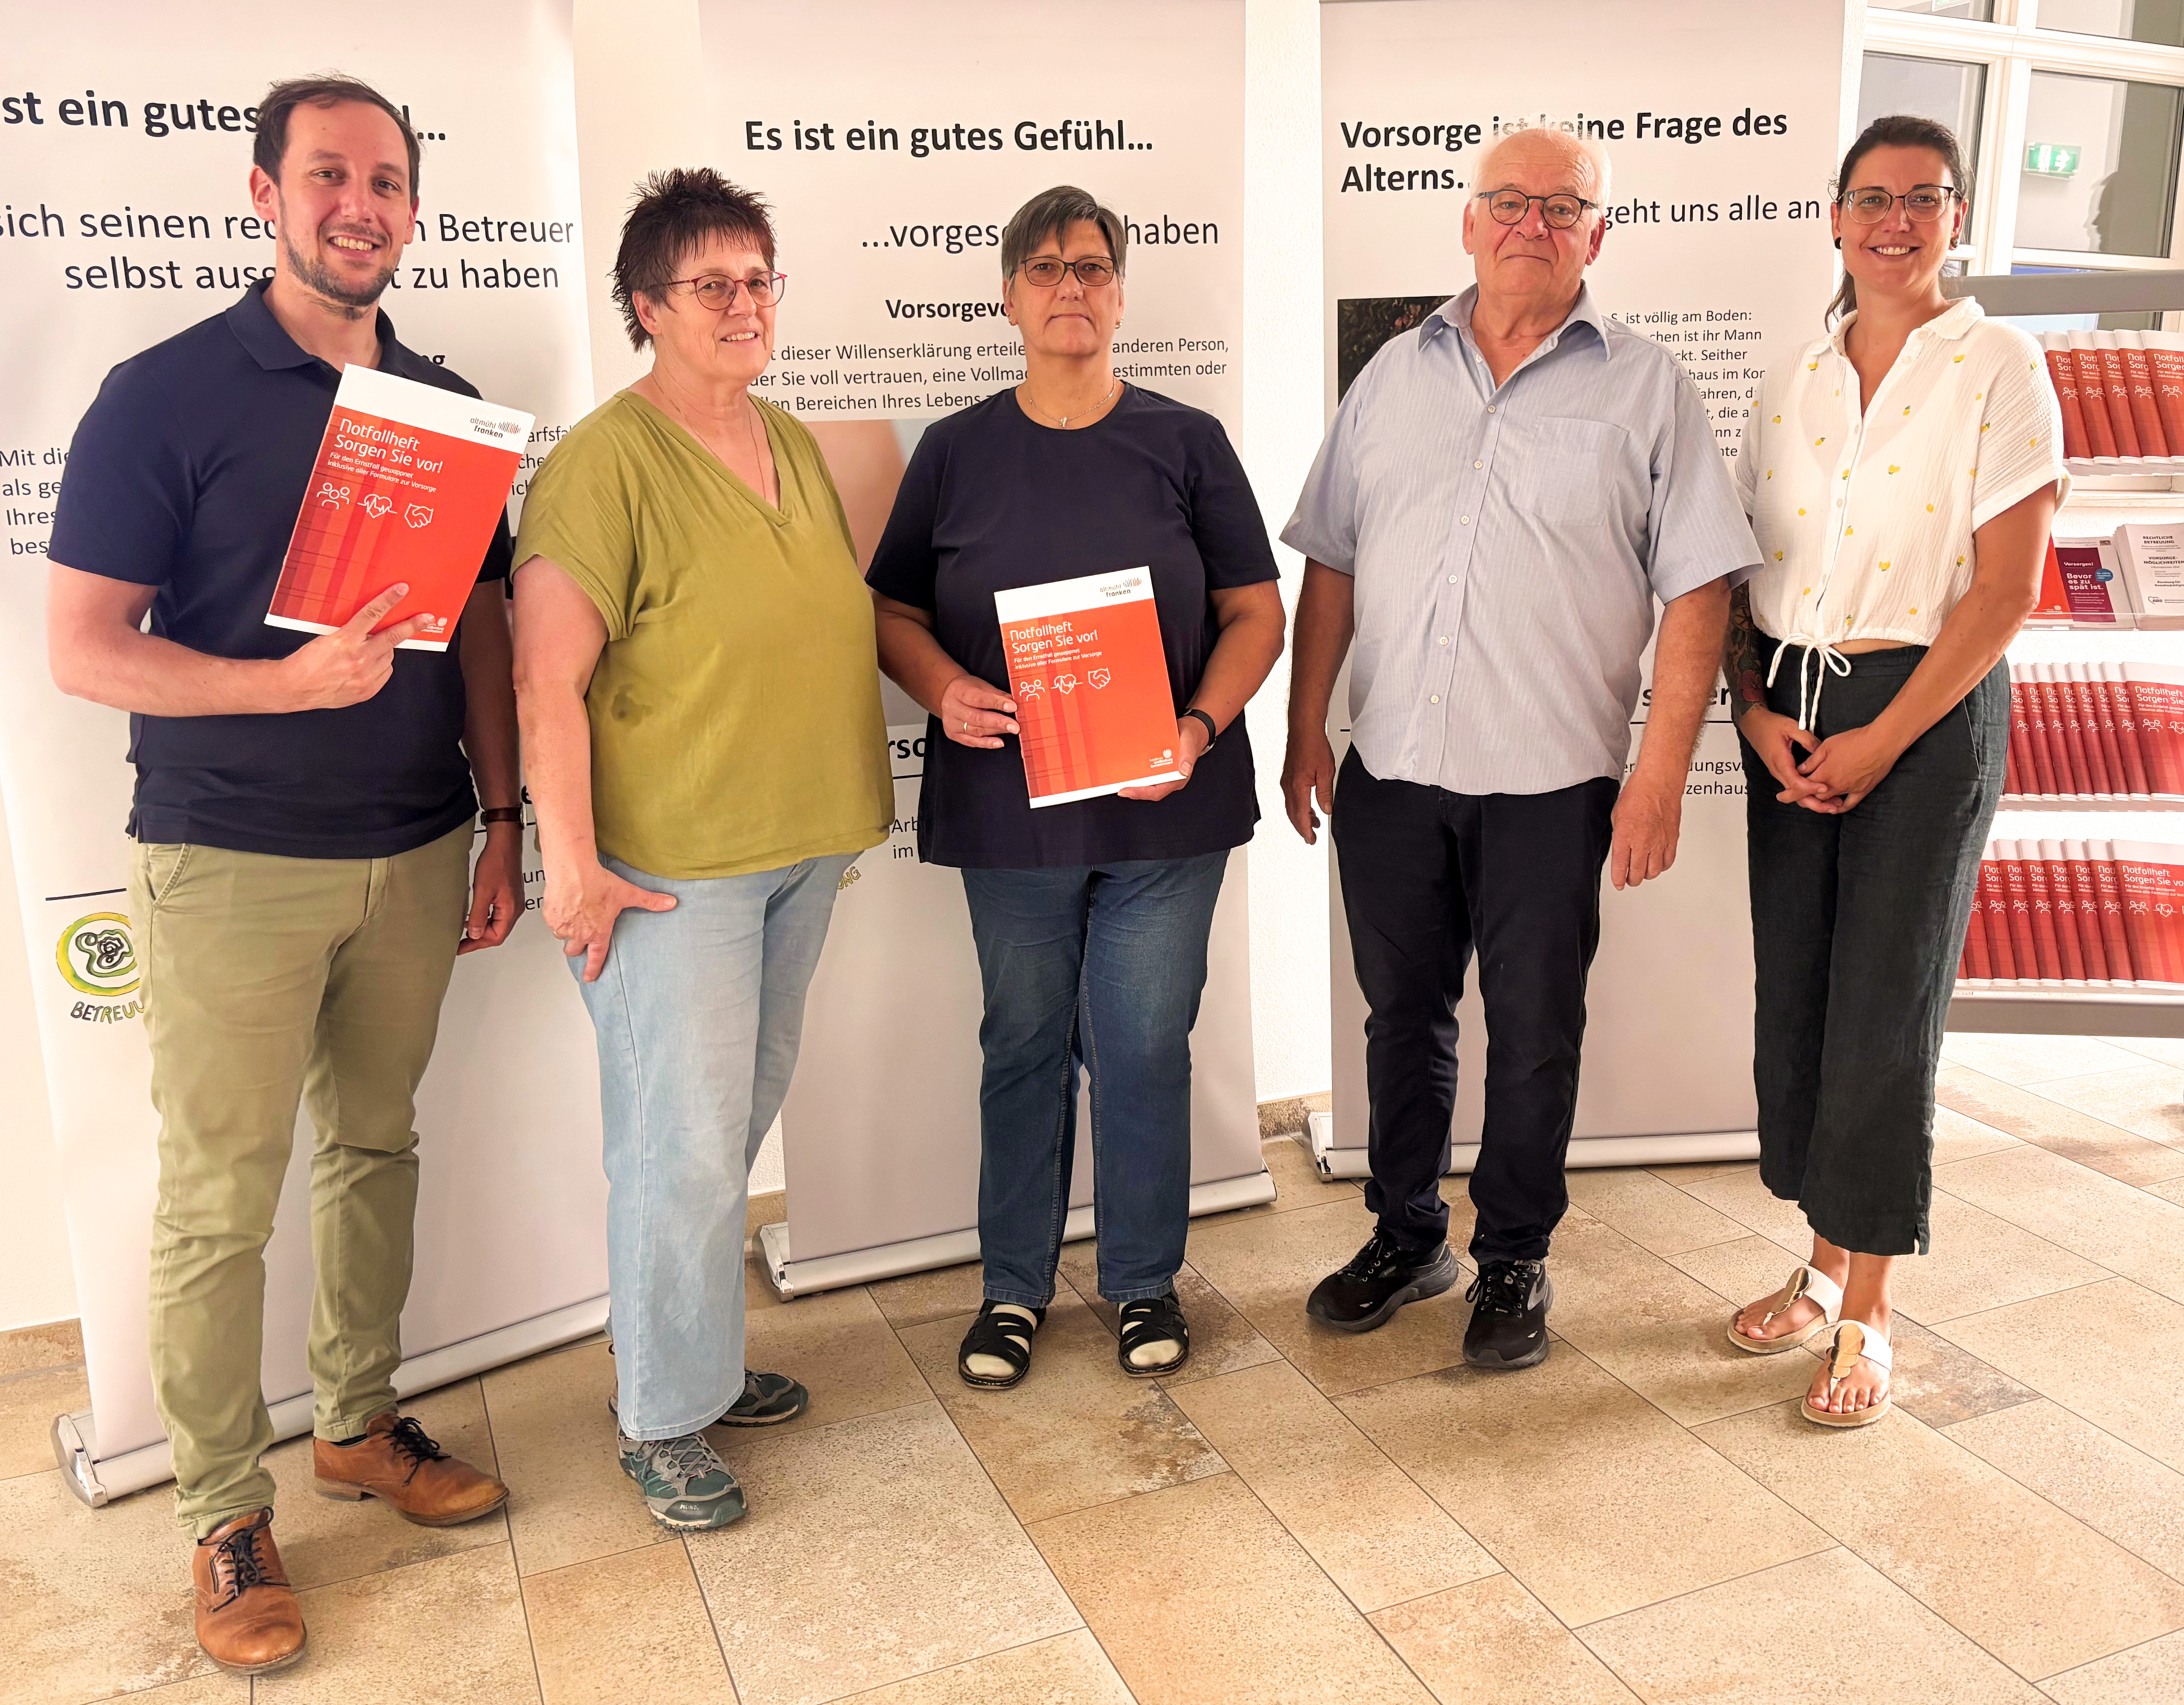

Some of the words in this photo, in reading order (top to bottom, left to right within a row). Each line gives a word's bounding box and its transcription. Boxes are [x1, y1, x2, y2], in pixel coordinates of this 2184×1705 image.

[2, 92, 44, 124] st
[58, 90, 128, 127] ein
[144, 99, 259, 137] gutes
[746, 121, 782, 150] Es
[794, 120, 834, 150] ist
[846, 120, 898, 150] ein
[911, 124, 1003, 157] gutes
[1014, 120, 1152, 150] Gefühl...
[1340, 122, 1481, 151] Vorsorge
[1637, 112, 1721, 144] Frage
[1732, 108, 1787, 136] des
[1671, 202, 1718, 222] uns
[1729, 195, 1777, 221] alle
[1788, 200, 1819, 219] an
[0, 204, 65, 237] ich
[80, 207, 210, 239] seinen
[439, 214, 573, 243] Betreuer
[1124, 215, 1218, 245] haben
[65, 256, 182, 289] selbst
[412, 267, 448, 288] zu
[461, 259, 558, 288] haben
[1626, 313, 1640, 324] ist
[1644, 312, 1678, 325] völlig
[1682, 313, 1702, 322] am
[1706, 309, 1752, 321] Boden:
[1684, 330, 1699, 342] ist
[1703, 330, 1720, 341] ihr
[1724, 329, 1762, 340] Mann
[781, 345, 831, 360] dieser
[836, 343, 972, 360] Willenserklärung
[977, 341, 1026, 357] erteile
[1113, 338, 1173, 353] anderen
[1178, 338, 1229, 353] Person,
[1701, 349, 1747, 360] Seither
[2154, 354, 2184, 363] Notfall
[782, 371, 805, 385] Sie
[811, 370, 838, 385] voll
[844, 369, 927, 385] vertrauen,
[932, 368, 966, 382] eine
[970, 366, 1028, 381] Vollma
[1113, 364, 1190, 377] estimmten
[1196, 361, 1227, 375] oder
[1722, 368, 1738, 379] im
[796, 395, 880, 411] Bereichen
[883, 394, 921, 409] Ihres
[927, 392, 980, 408] Lebens
[1718, 407, 1738, 418] die
[470, 417, 496, 429] altmühl
[474, 425, 503, 438] franken
[339, 418, 420, 452] Notfallheft
[0, 449, 36, 467] Mit
[334, 435, 386, 459] Sorgen
[390, 449, 412, 466] Sie
[417, 458, 443, 474] vor!
[327, 460, 354, 472] inklusive
[355, 466, 369, 475] aller
[370, 471, 400, 483] Formulare
[411, 481, 436, 493] Vorsorge
[342, 455, 354, 463] den
[355, 458, 380, 470] Ernstfall
[380, 466, 414, 479] gewappnet
[2, 478, 31, 496] als
[39, 482, 61, 499] ge
[11, 538, 50, 555] bes
[1106, 589, 1131, 598] franken
[1010, 621, 1073, 641] Notfallheft
[1012, 639, 1053, 654] Sorgen
[1055, 636, 1073, 646] Sie
[1076, 630, 1098, 642] vor!
[2135, 686, 2184, 697] Notfallheft
[2137, 694, 2168, 703] Sorgen
[893, 845, 913, 859] im
[2122, 866, 2171, 877] Notfallheft
[2124, 874, 2155, 884] Sorgen
[71, 1001, 144, 1024] BETREUU
